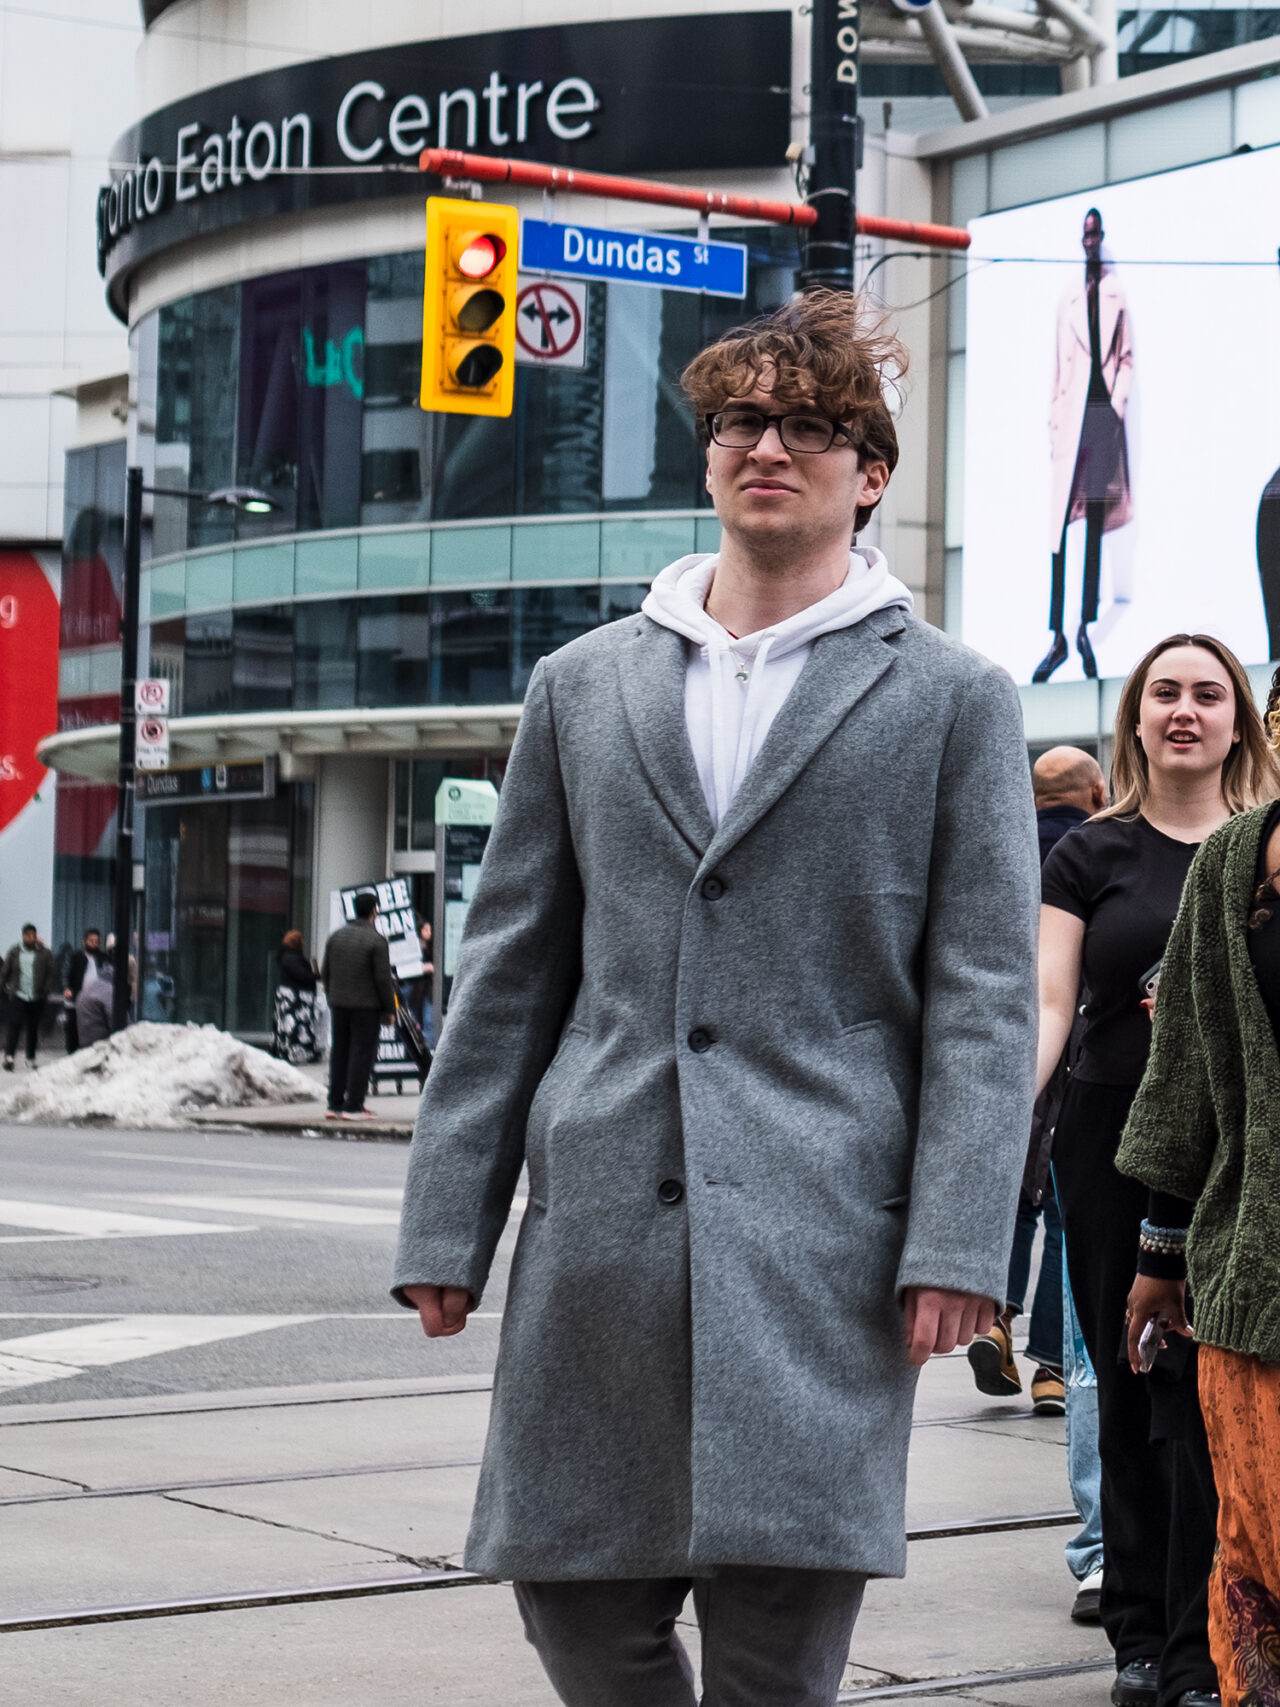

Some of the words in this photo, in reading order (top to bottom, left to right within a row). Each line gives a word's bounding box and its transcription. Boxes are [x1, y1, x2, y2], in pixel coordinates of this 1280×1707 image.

[175, 112, 312, 202] Eaton
[336, 71, 596, 162] Centre
[563, 227, 682, 276] Dundas
[693, 245, 709, 265] St
